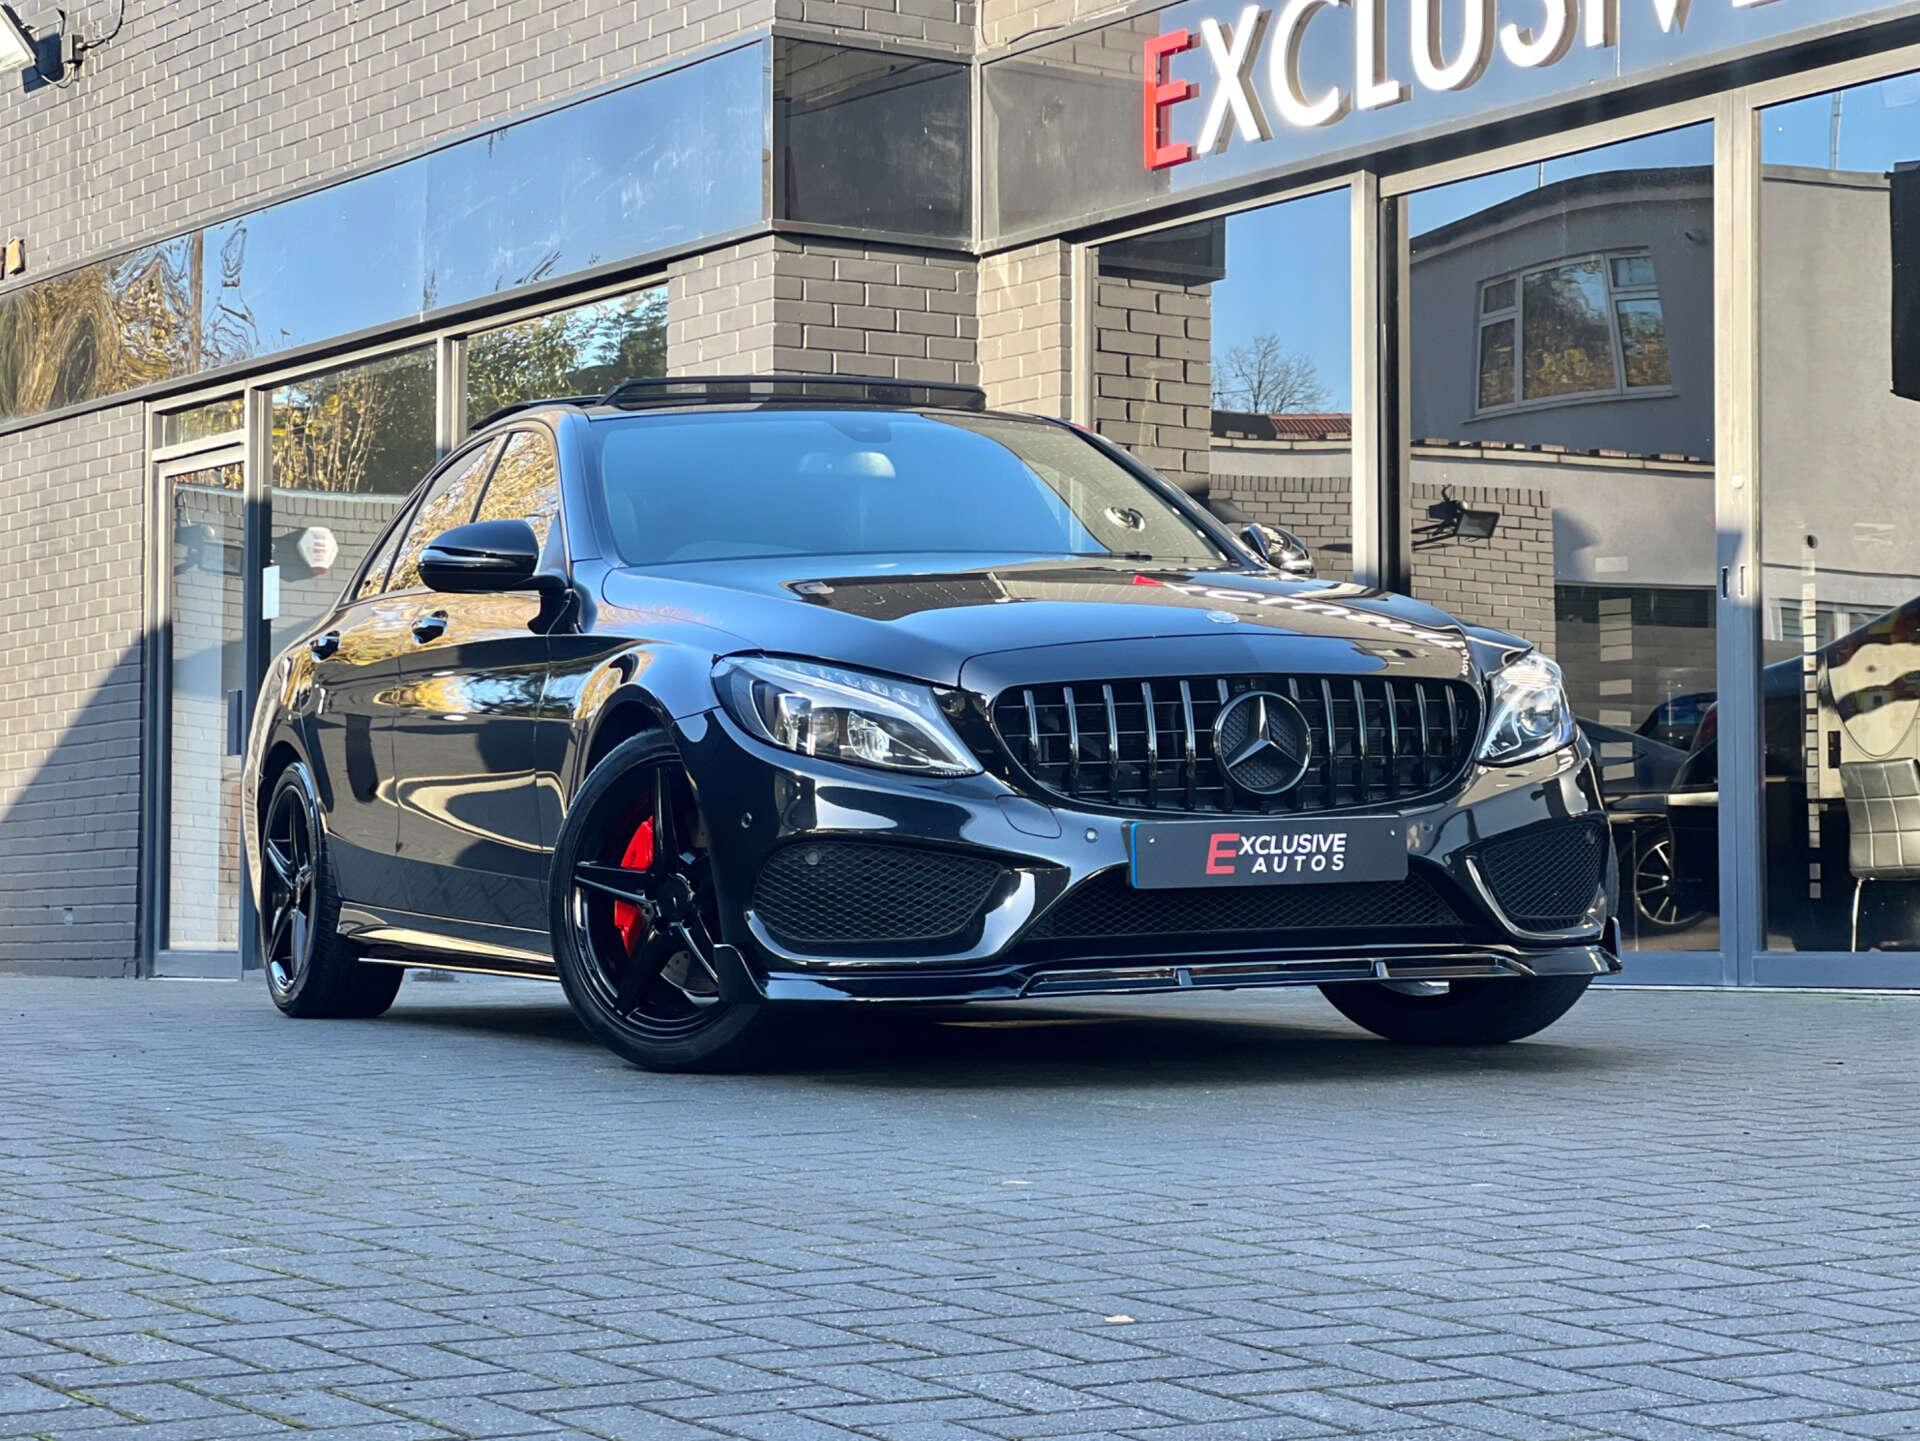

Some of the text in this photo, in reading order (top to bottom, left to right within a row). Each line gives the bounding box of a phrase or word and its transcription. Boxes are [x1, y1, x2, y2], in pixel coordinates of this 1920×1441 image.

[1144, 0, 1764, 170] EXCLU
[1206, 832, 1347, 875] EXCLUSIVE
[1251, 854, 1345, 874] AUTOS
